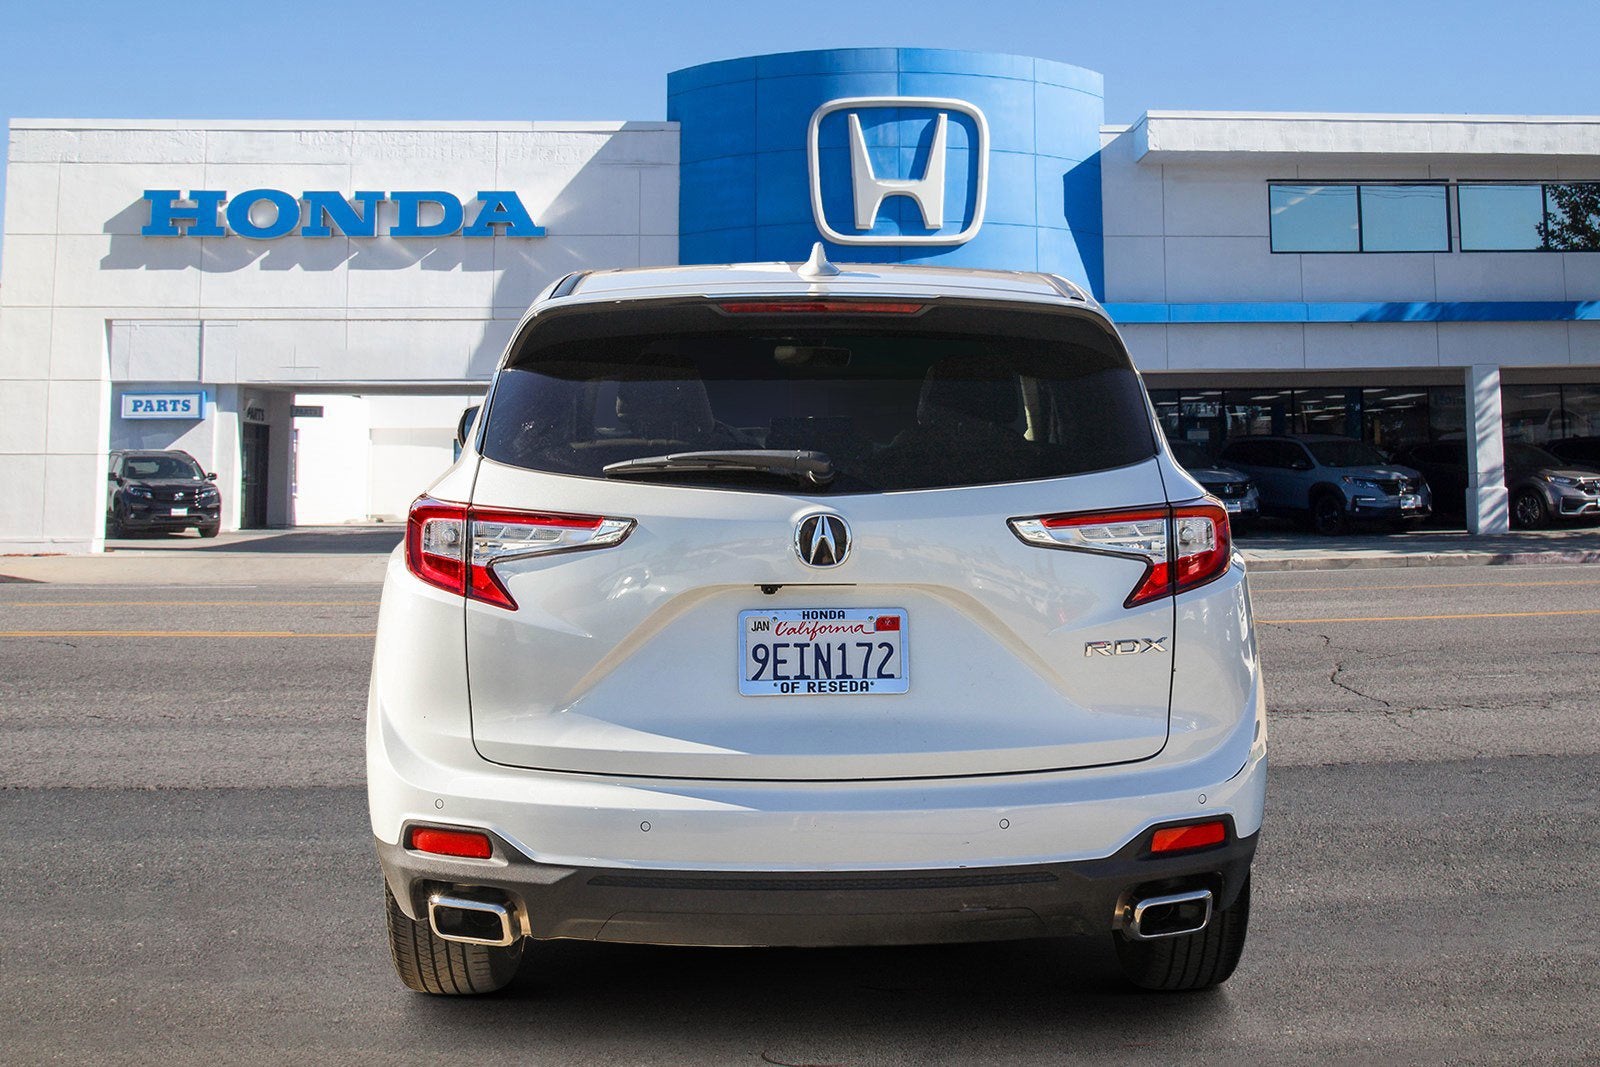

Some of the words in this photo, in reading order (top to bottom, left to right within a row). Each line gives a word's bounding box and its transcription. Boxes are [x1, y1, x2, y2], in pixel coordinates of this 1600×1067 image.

[141, 189, 548, 240] HONDA
[132, 399, 191, 412] PARTS
[802, 610, 846, 620] HONDA
[751, 621, 770, 632] JAN
[775, 621, 875, 641] California
[1084, 637, 1168, 657] RDX
[751, 642, 895, 681] 9EIN172
[780, 682, 800, 694] OF
[807, 681, 870, 693] RESEDA
